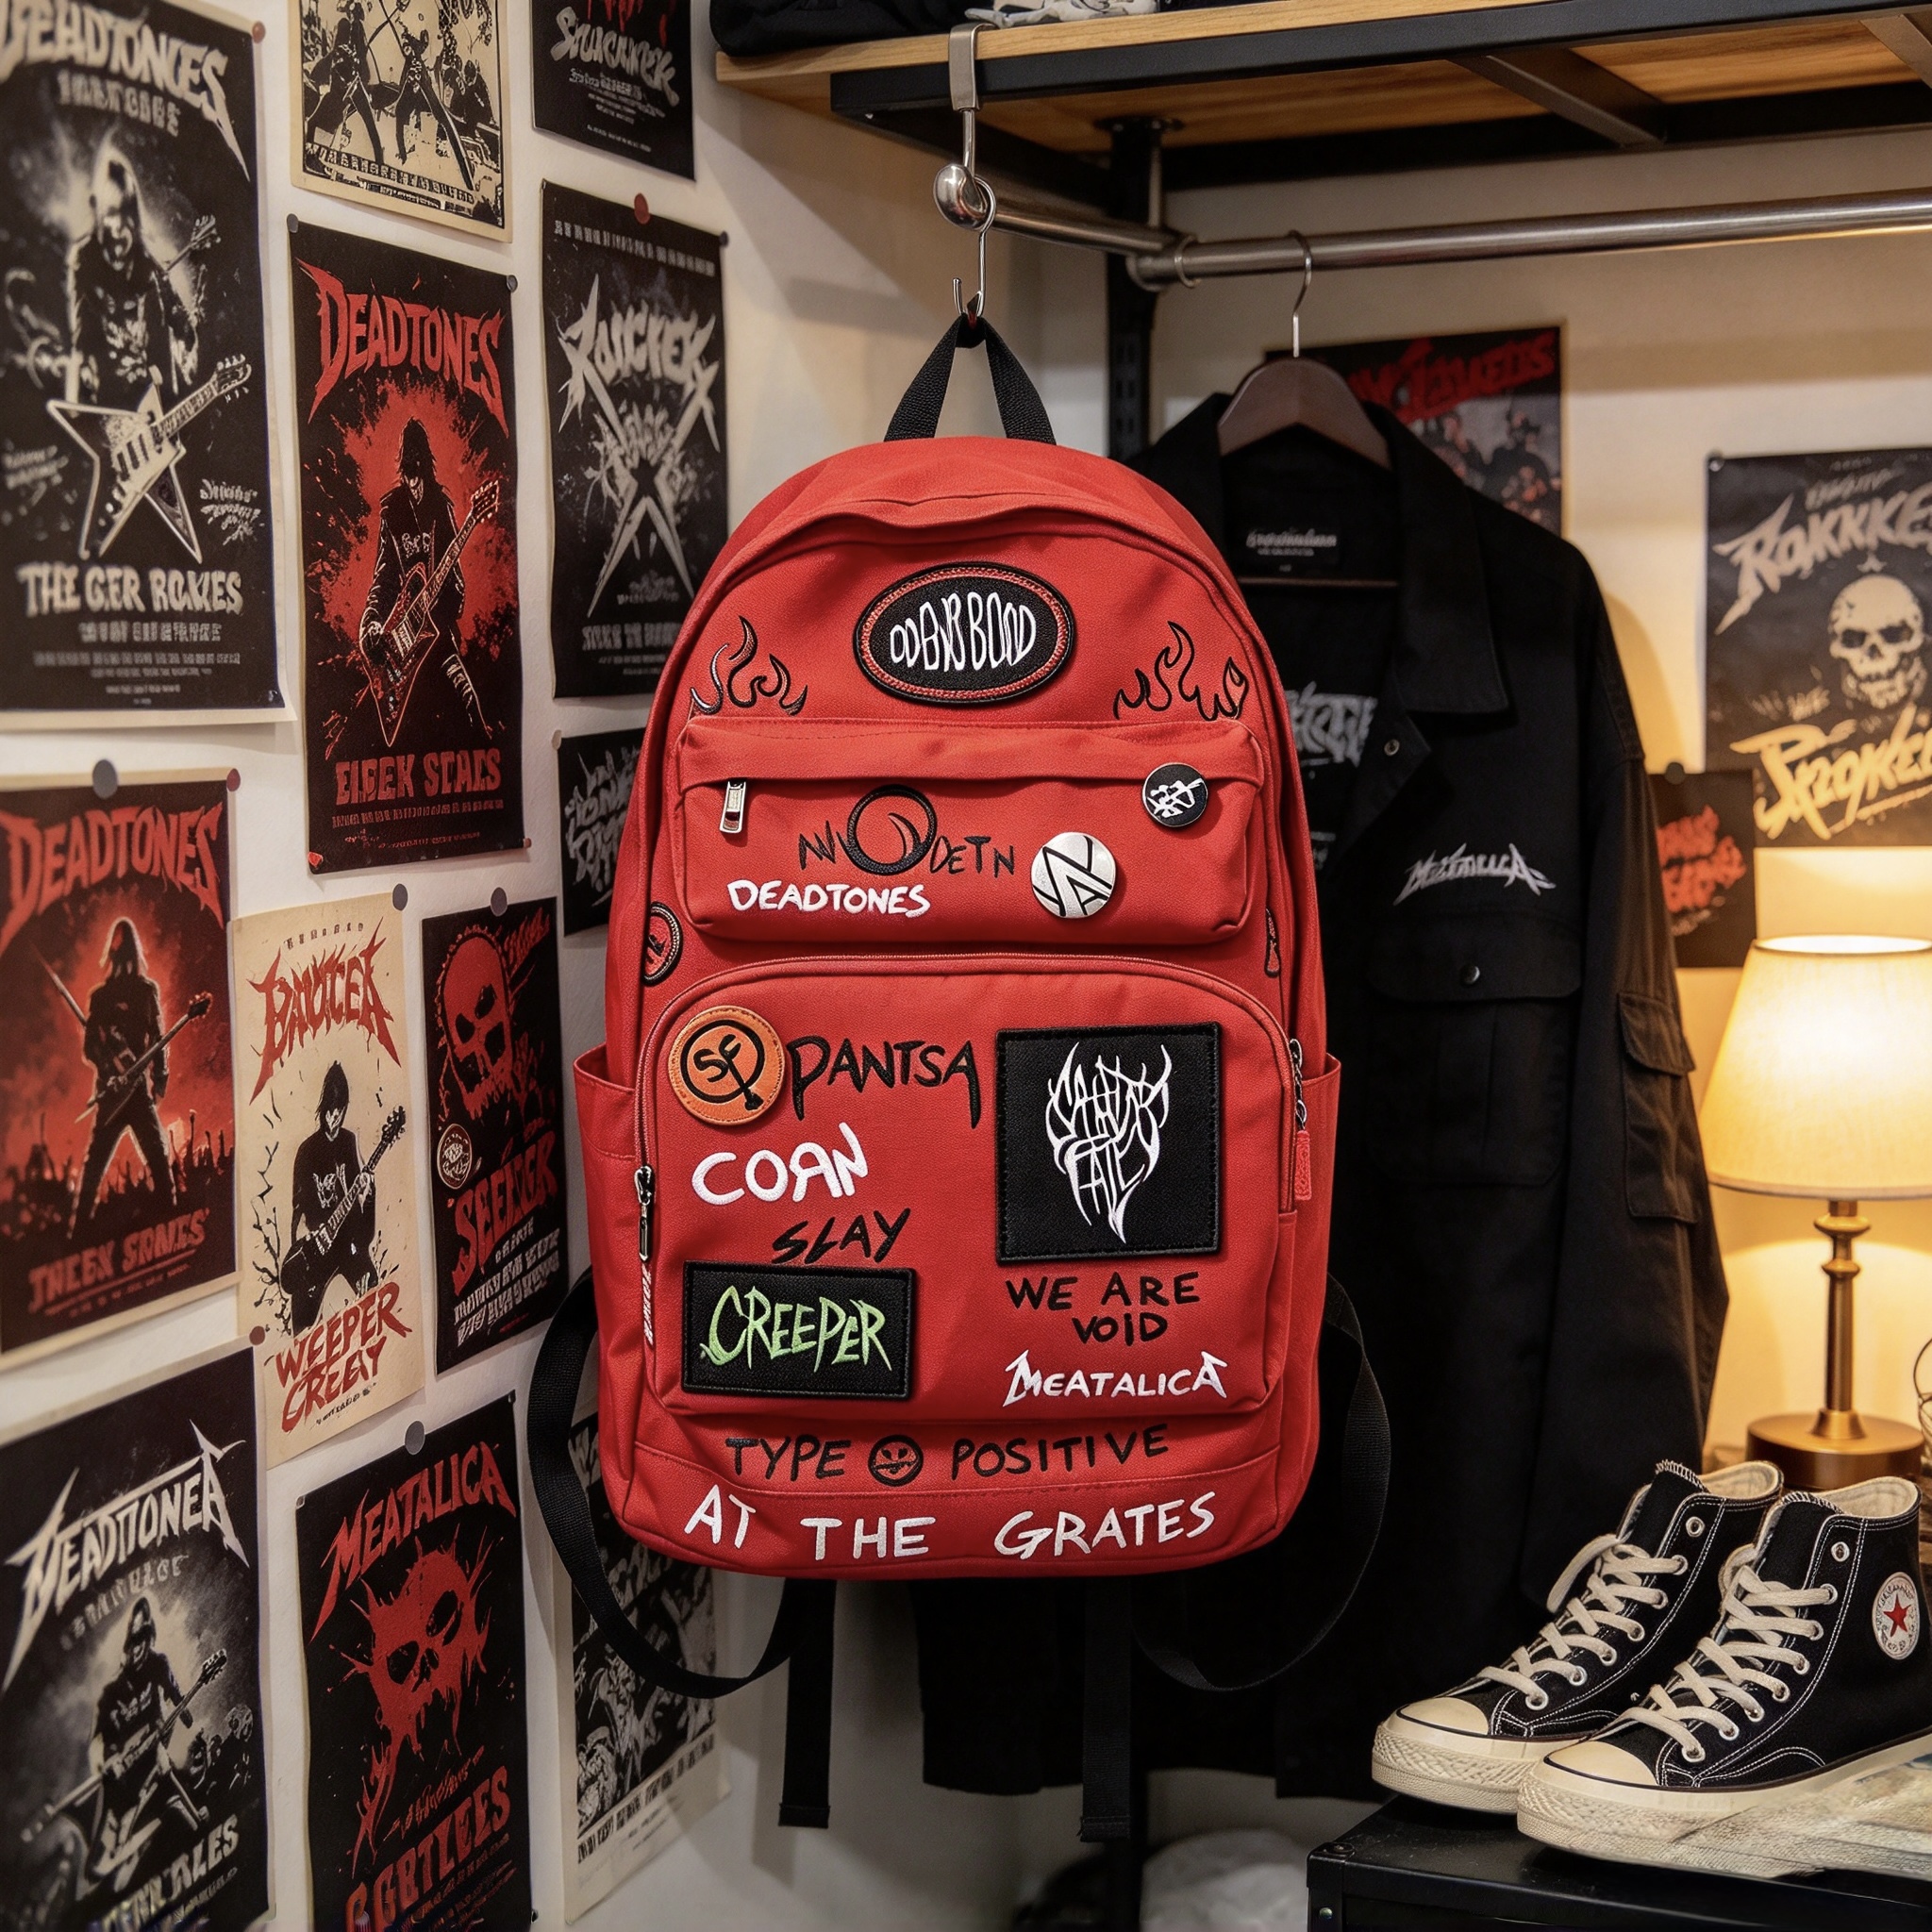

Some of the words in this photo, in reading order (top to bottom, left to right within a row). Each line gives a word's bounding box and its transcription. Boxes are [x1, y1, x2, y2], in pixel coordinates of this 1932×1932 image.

[295, 257, 509, 439] DEADTONES
[0, 802, 225, 958] DEADTONES
[726, 879, 931, 918] DEADTONES
[786, 1035, 981, 1129] PANTSA
[772, 1208, 910, 1264] SLAY
[699, 1285, 892, 1373] CREEPER
[1006, 1276, 1077, 1310] WE
[1101, 1272, 1200, 1307] ARE
[1072, 1312, 1168, 1346] VOID
[275, 1281, 413, 1389] WEEPER
[1003, 1350, 1227, 1407] MEATALICA
[724, 1437, 851, 1481] TYPE
[951, 1424, 1169, 1481] POSITIVE
[308, 1441, 517, 1645] MEATALICA
[684, 1484, 756, 1549] AT
[800, 1516, 936, 1560] THE
[994, 1491, 1215, 1560] GRATES
